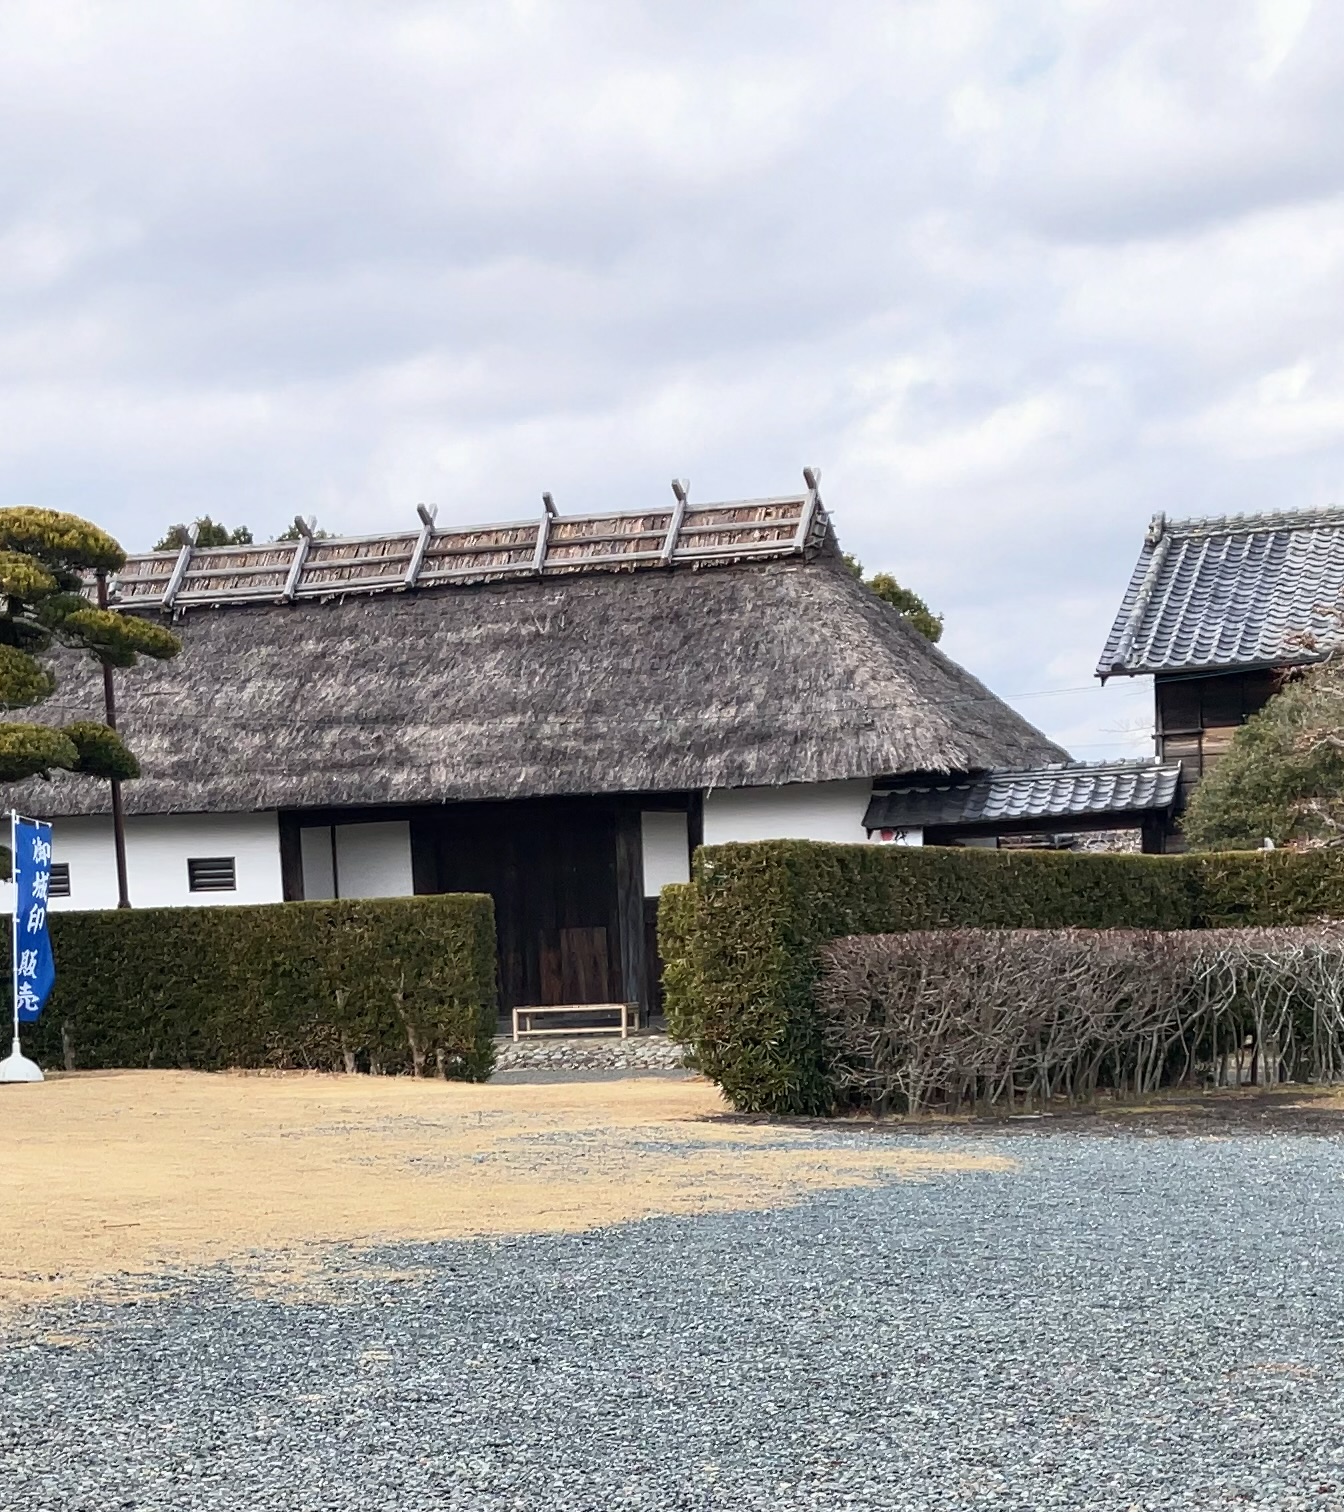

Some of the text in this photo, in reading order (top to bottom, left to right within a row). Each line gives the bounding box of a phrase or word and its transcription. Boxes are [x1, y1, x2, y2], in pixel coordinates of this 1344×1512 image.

[17, 836, 51, 1011] 御城印 販売
